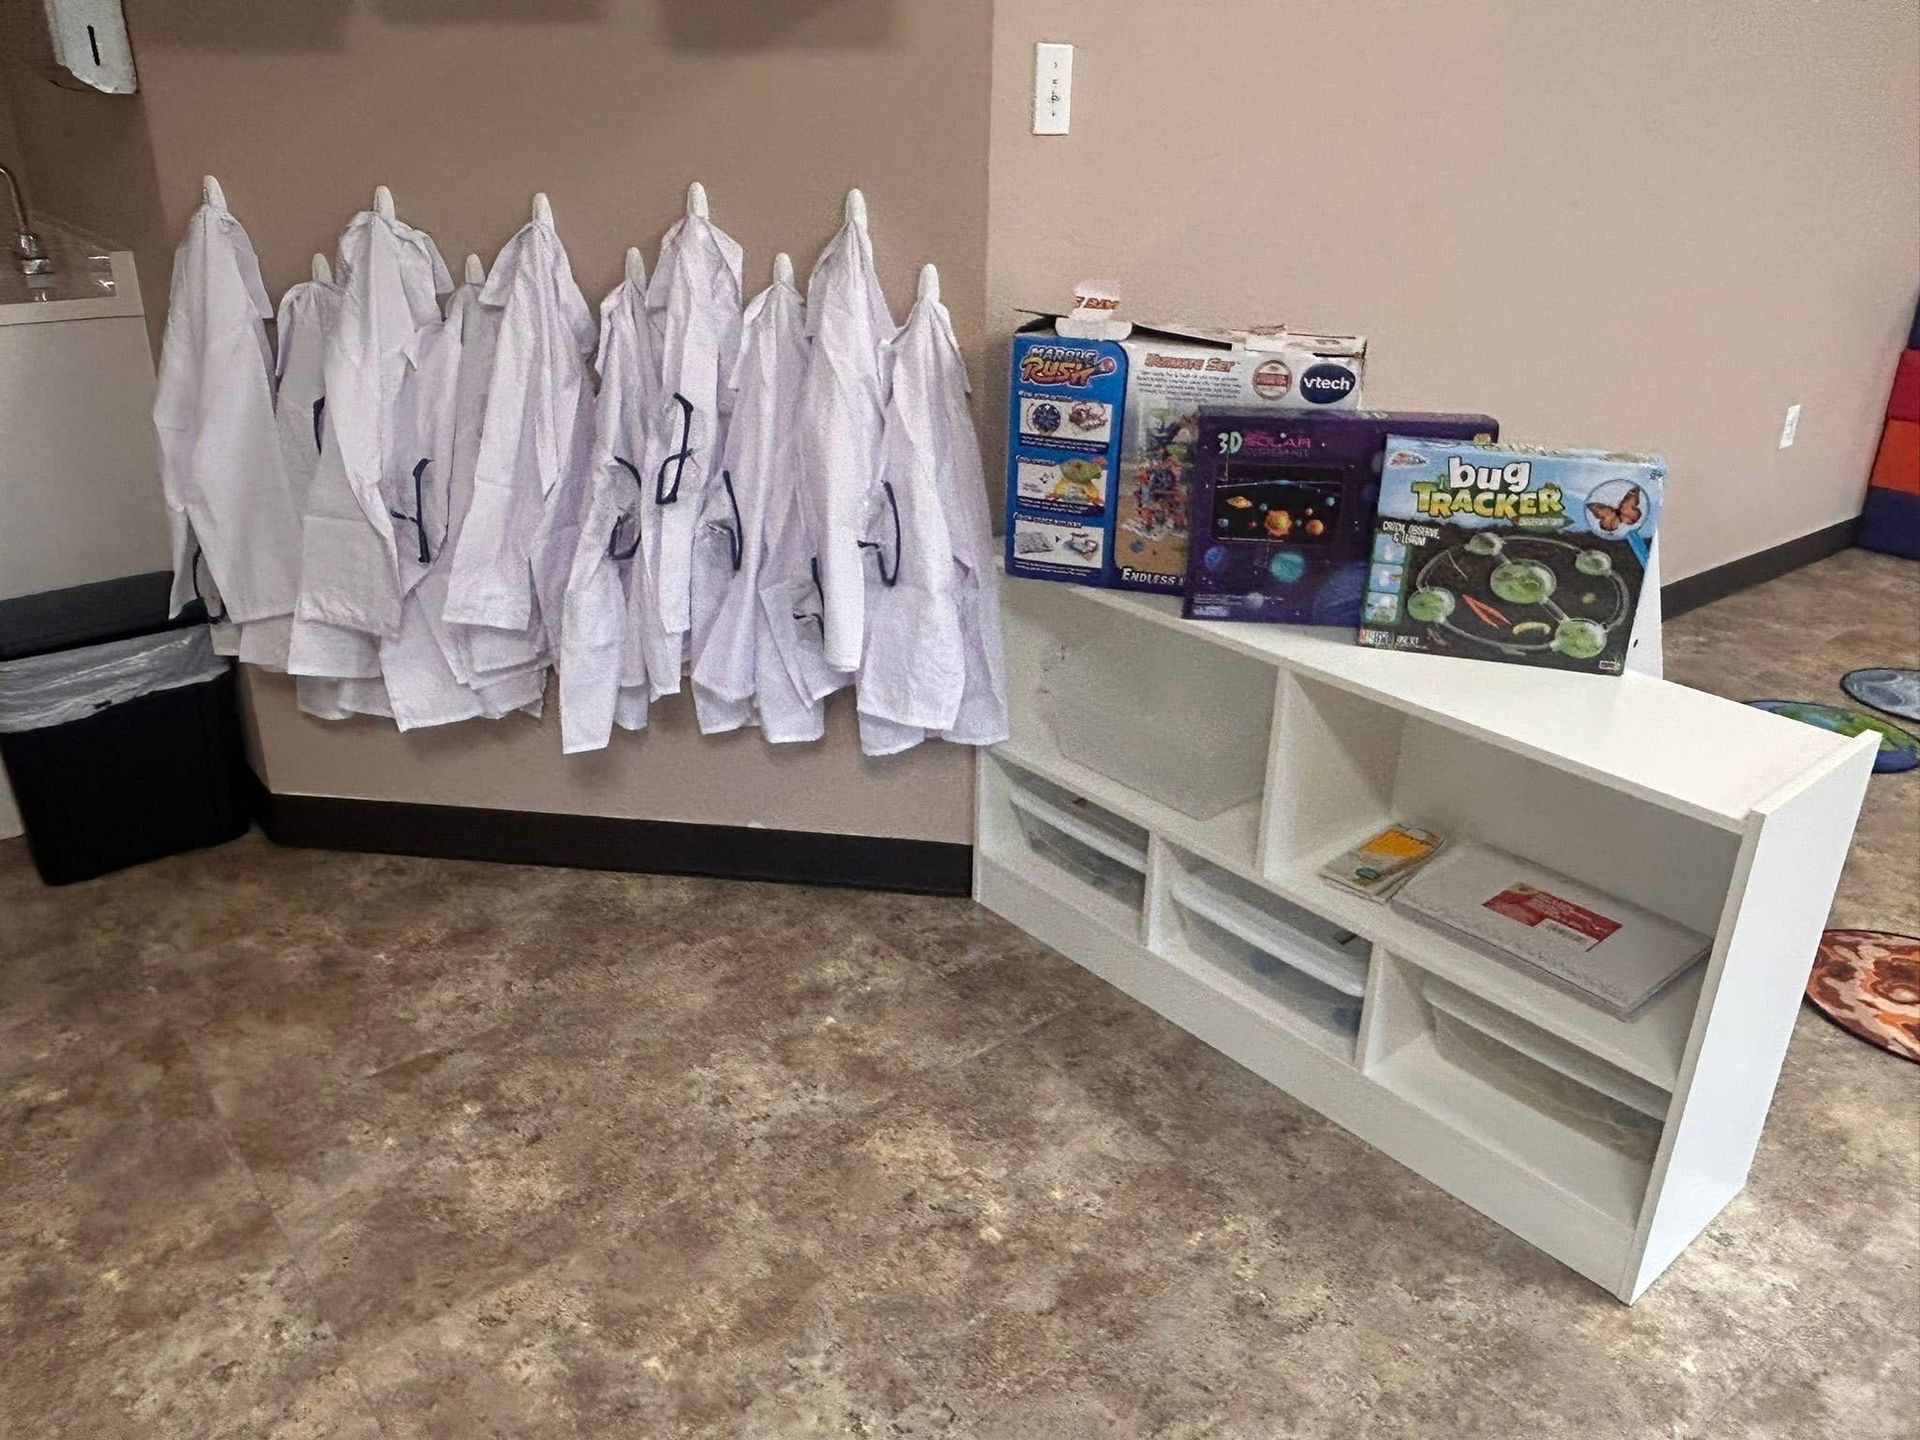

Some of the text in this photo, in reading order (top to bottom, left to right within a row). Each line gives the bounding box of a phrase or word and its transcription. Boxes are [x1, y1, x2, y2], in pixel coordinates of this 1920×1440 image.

[1021, 356, 1095, 387] RUSH
[1303, 377, 1351, 391] vtech
[1217, 431, 1243, 454] 3D
[1448, 455, 1532, 493] bug
[1411, 481, 1566, 520] TRACKER
[1121, 567, 1177, 586] ENDLESS
